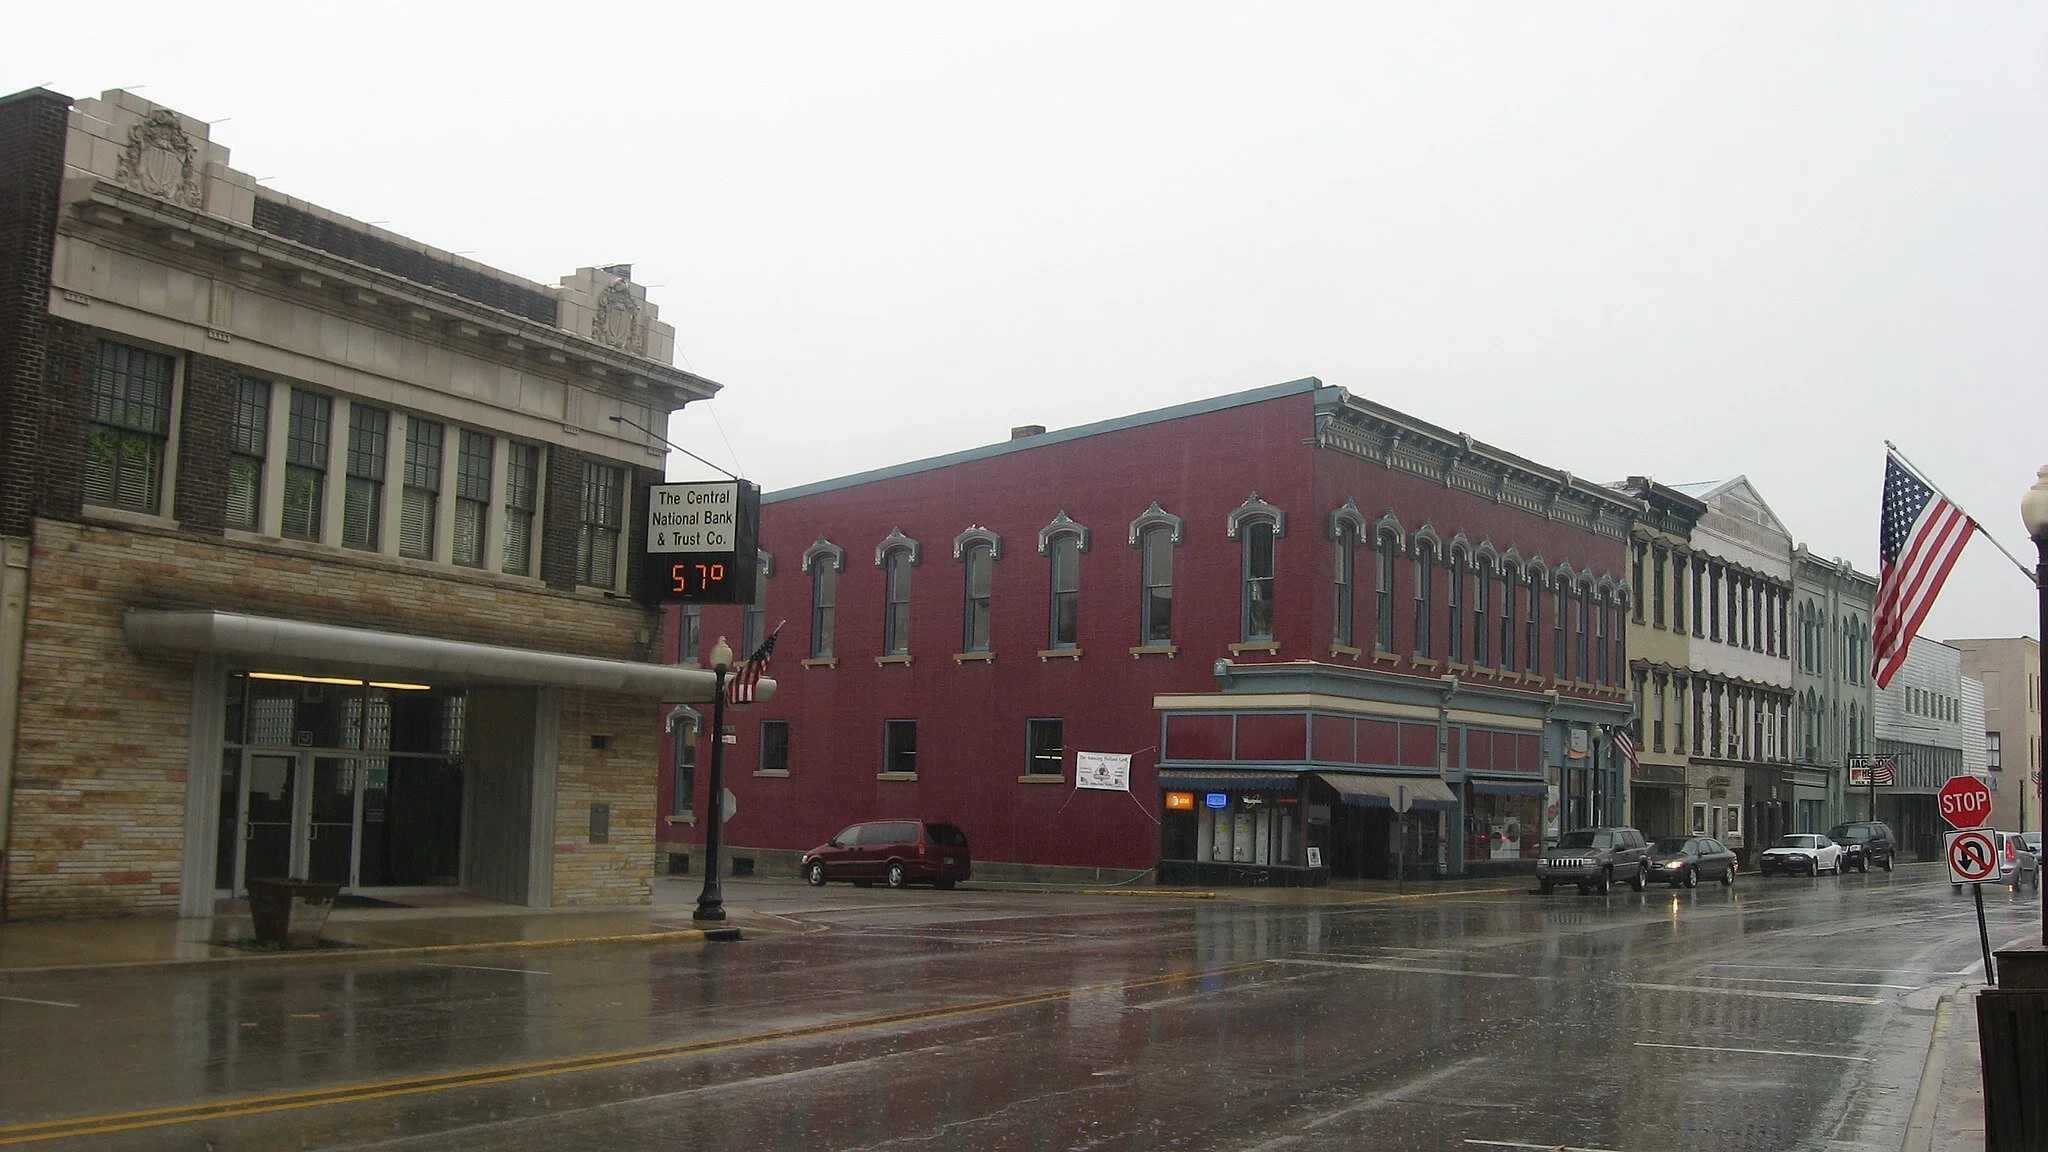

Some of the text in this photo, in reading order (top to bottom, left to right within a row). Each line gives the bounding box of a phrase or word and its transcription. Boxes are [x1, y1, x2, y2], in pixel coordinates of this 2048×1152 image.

[659, 490, 730, 505] The Central
[652, 510, 733, 526] National Bank
[657, 531, 726, 546] & Trust Co.
[1943, 791, 1987, 813] STOP
